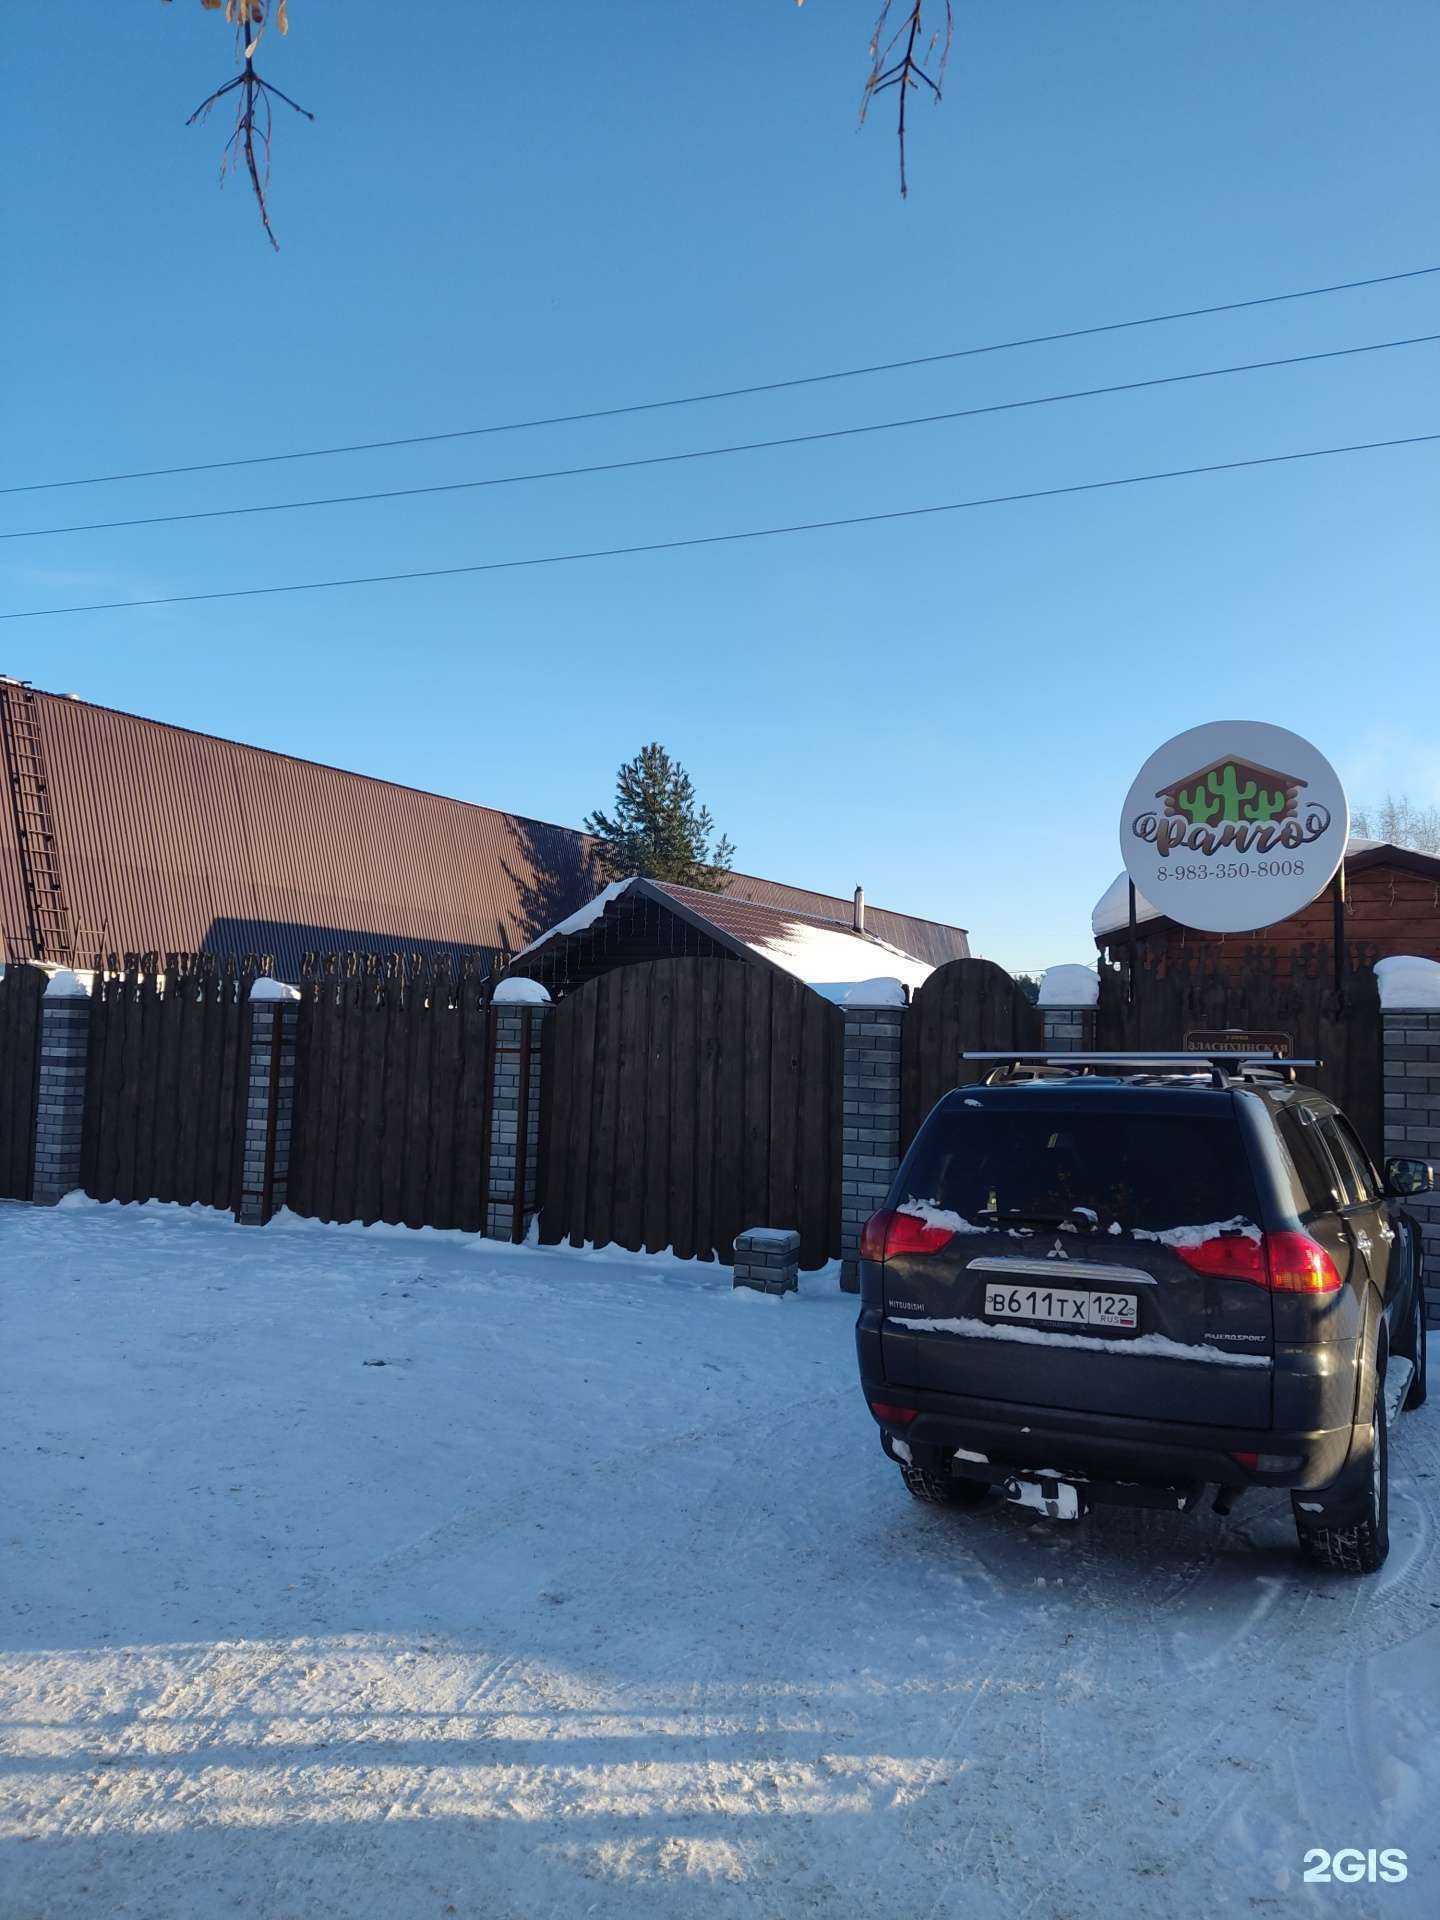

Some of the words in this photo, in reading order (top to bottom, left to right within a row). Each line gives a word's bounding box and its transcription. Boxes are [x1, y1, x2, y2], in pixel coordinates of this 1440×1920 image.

[1157, 860, 1305, 882] 8-983-350-8008
[888, 1298, 925, 1312] MITSUBISHI
[1092, 1295, 1129, 1317] 122
[1100, 1315, 1120, 1324] RUS
